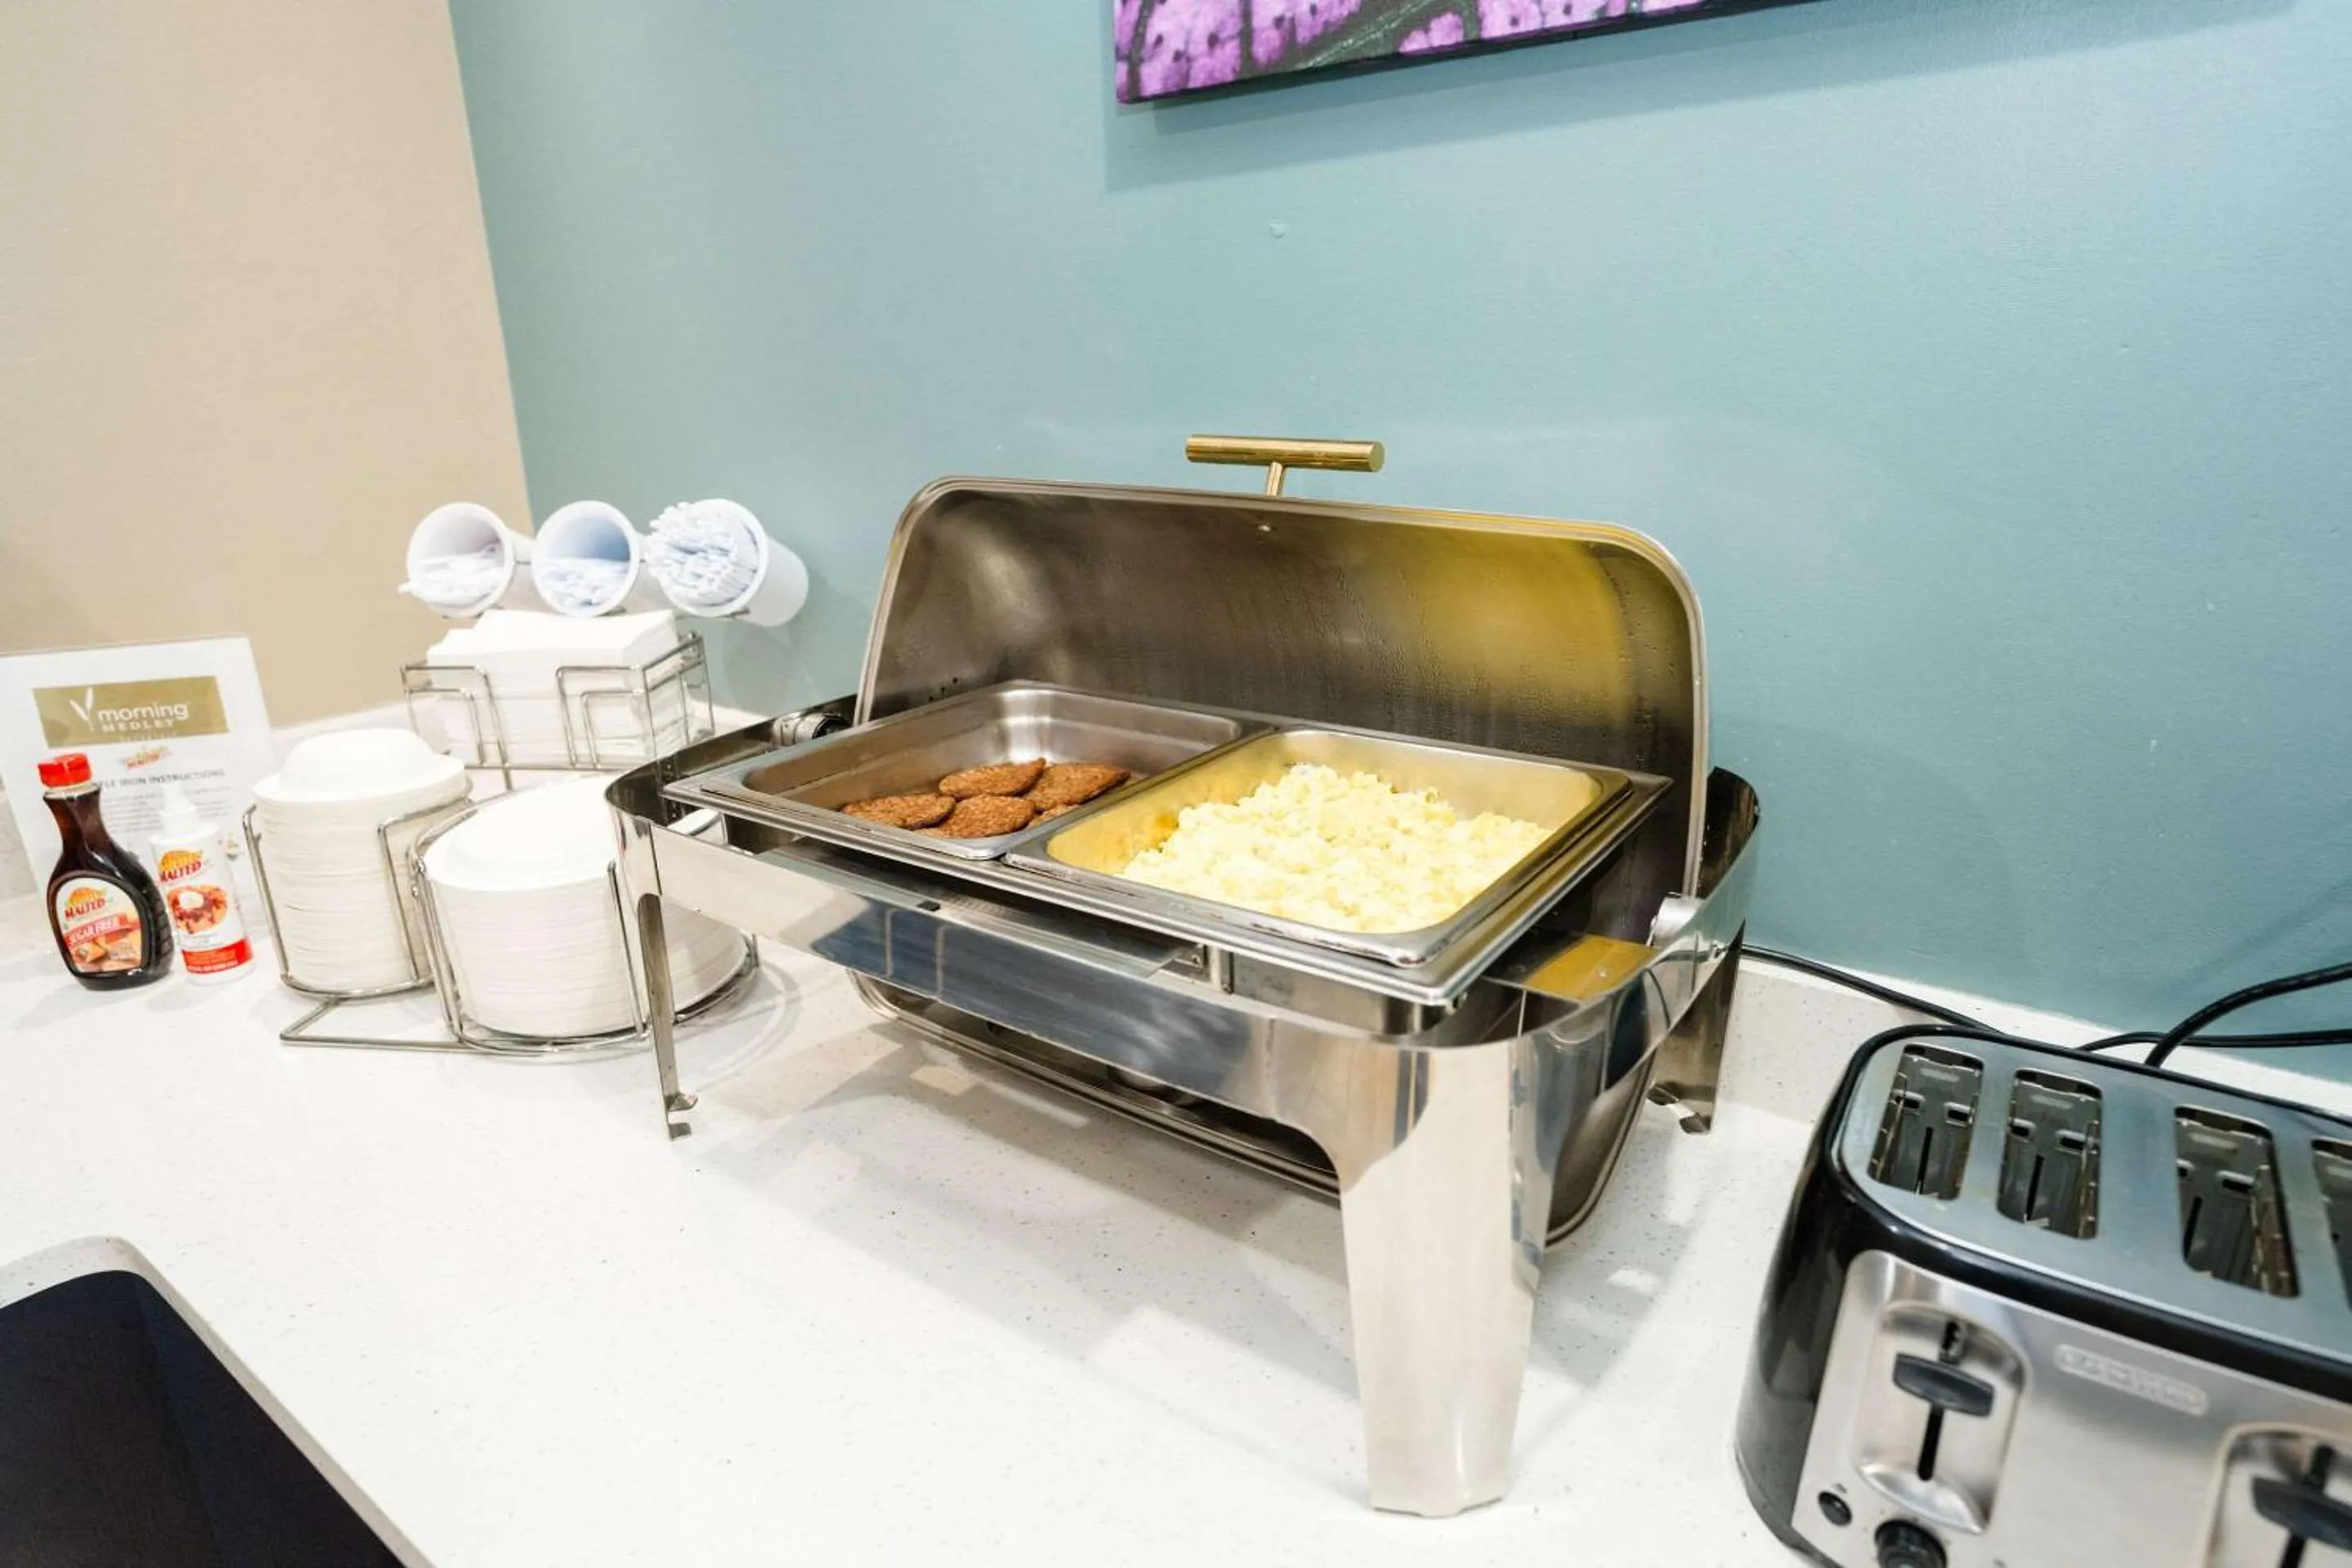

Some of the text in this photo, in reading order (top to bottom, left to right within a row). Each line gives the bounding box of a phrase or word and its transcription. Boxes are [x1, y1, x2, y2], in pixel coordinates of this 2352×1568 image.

[98, 702, 189, 722] morning
[101, 718, 175, 733] MEDLEY
[158, 860, 202, 882] MALTED
[65, 898, 106, 919] MALTED
